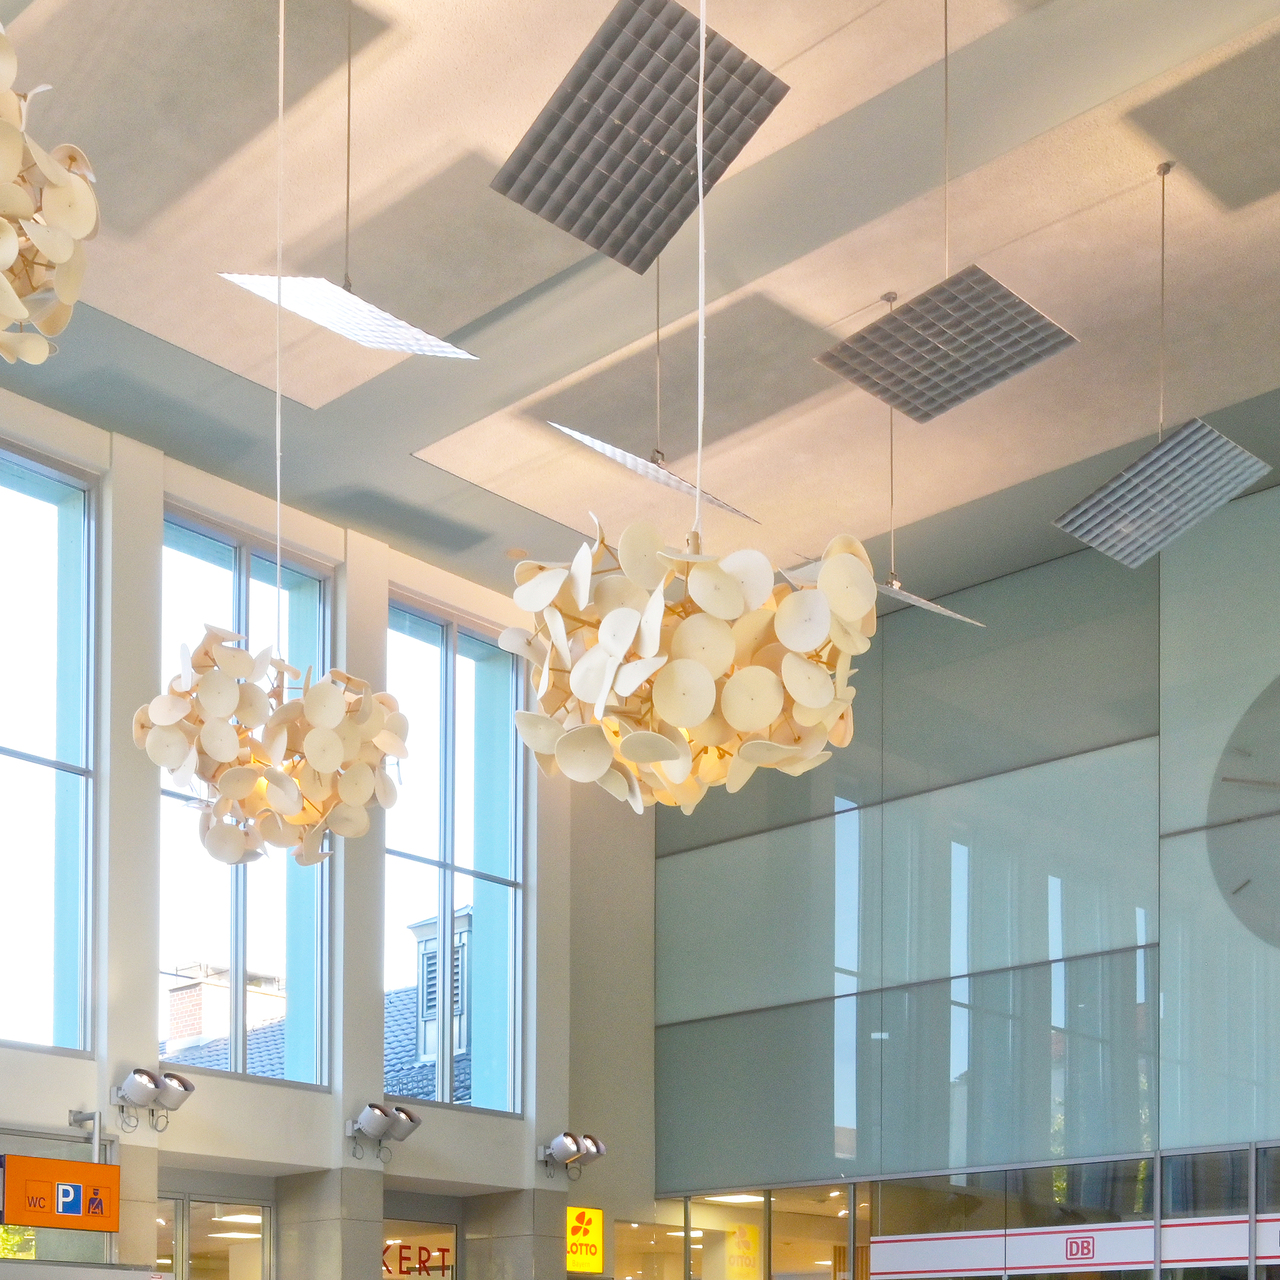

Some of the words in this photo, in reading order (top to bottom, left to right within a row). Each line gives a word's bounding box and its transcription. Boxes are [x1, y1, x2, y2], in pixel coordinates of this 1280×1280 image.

[27, 1195, 46, 1209] WC
[58, 1184, 75, 1213] P
[1069, 1240, 1092, 1257] DB
[572, 1259, 591, 1269] Bayern
